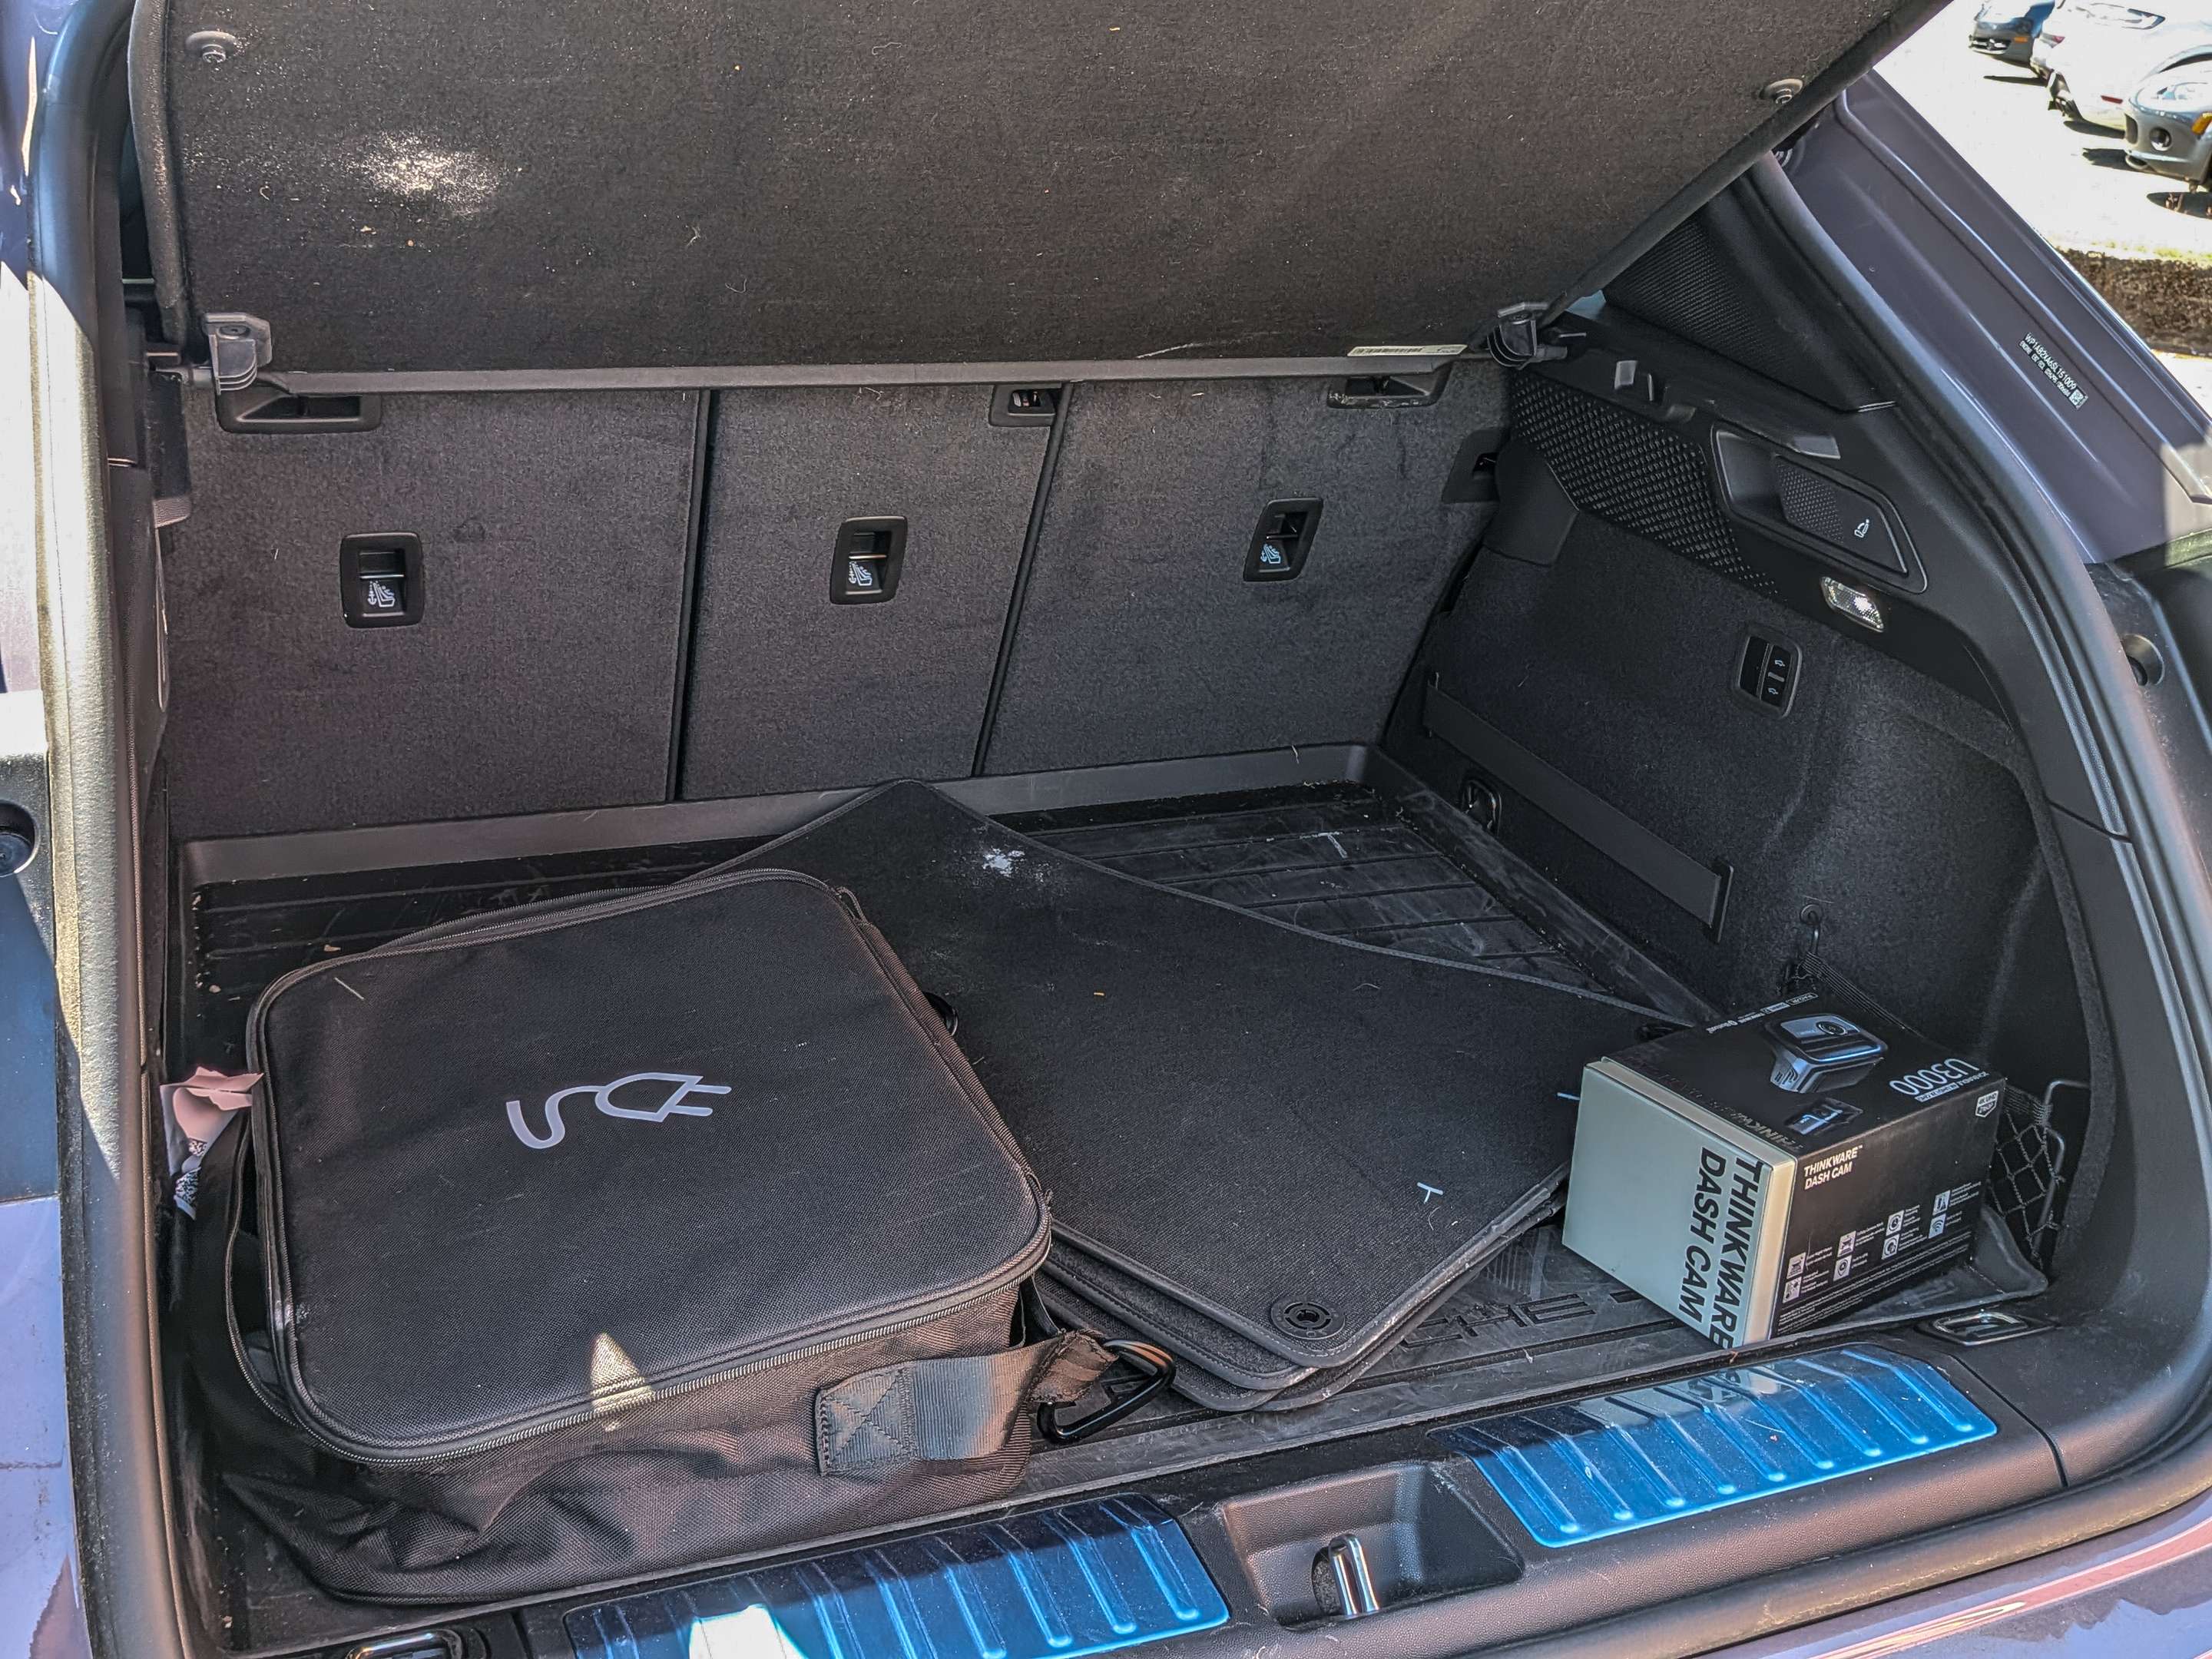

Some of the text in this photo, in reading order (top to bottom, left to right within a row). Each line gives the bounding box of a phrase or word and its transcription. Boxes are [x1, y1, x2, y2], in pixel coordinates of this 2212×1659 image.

[1889, 1058, 1980, 1096] U3000
[1803, 1146, 1859, 1177] THINKWARE
[1804, 1161, 1853, 1190] DASH CAM
[1678, 1147, 1727, 1323] DASH CAM
[1709, 1156, 1764, 1349] THINKWARE
